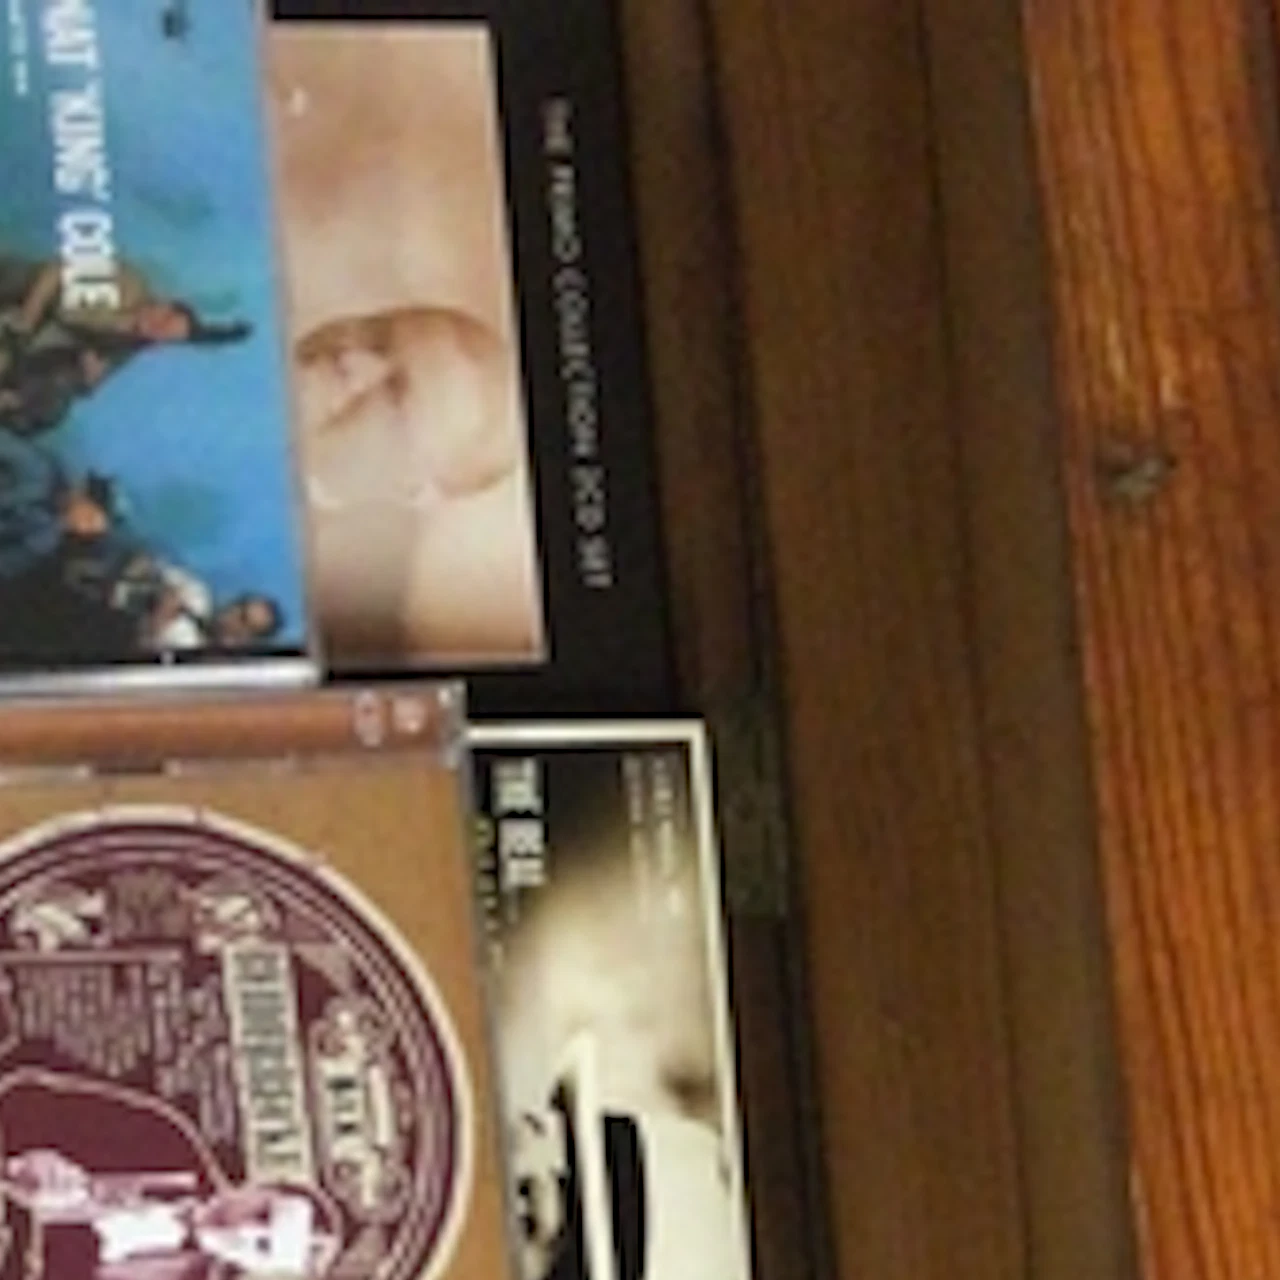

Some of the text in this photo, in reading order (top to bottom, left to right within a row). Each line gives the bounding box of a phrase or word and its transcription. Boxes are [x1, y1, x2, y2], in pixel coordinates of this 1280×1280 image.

[54, 209, 119, 311] COLE
[542, 97, 613, 590] THE PRIMO COLLECTION 2CD SET
[490, 757, 543, 816] THE
